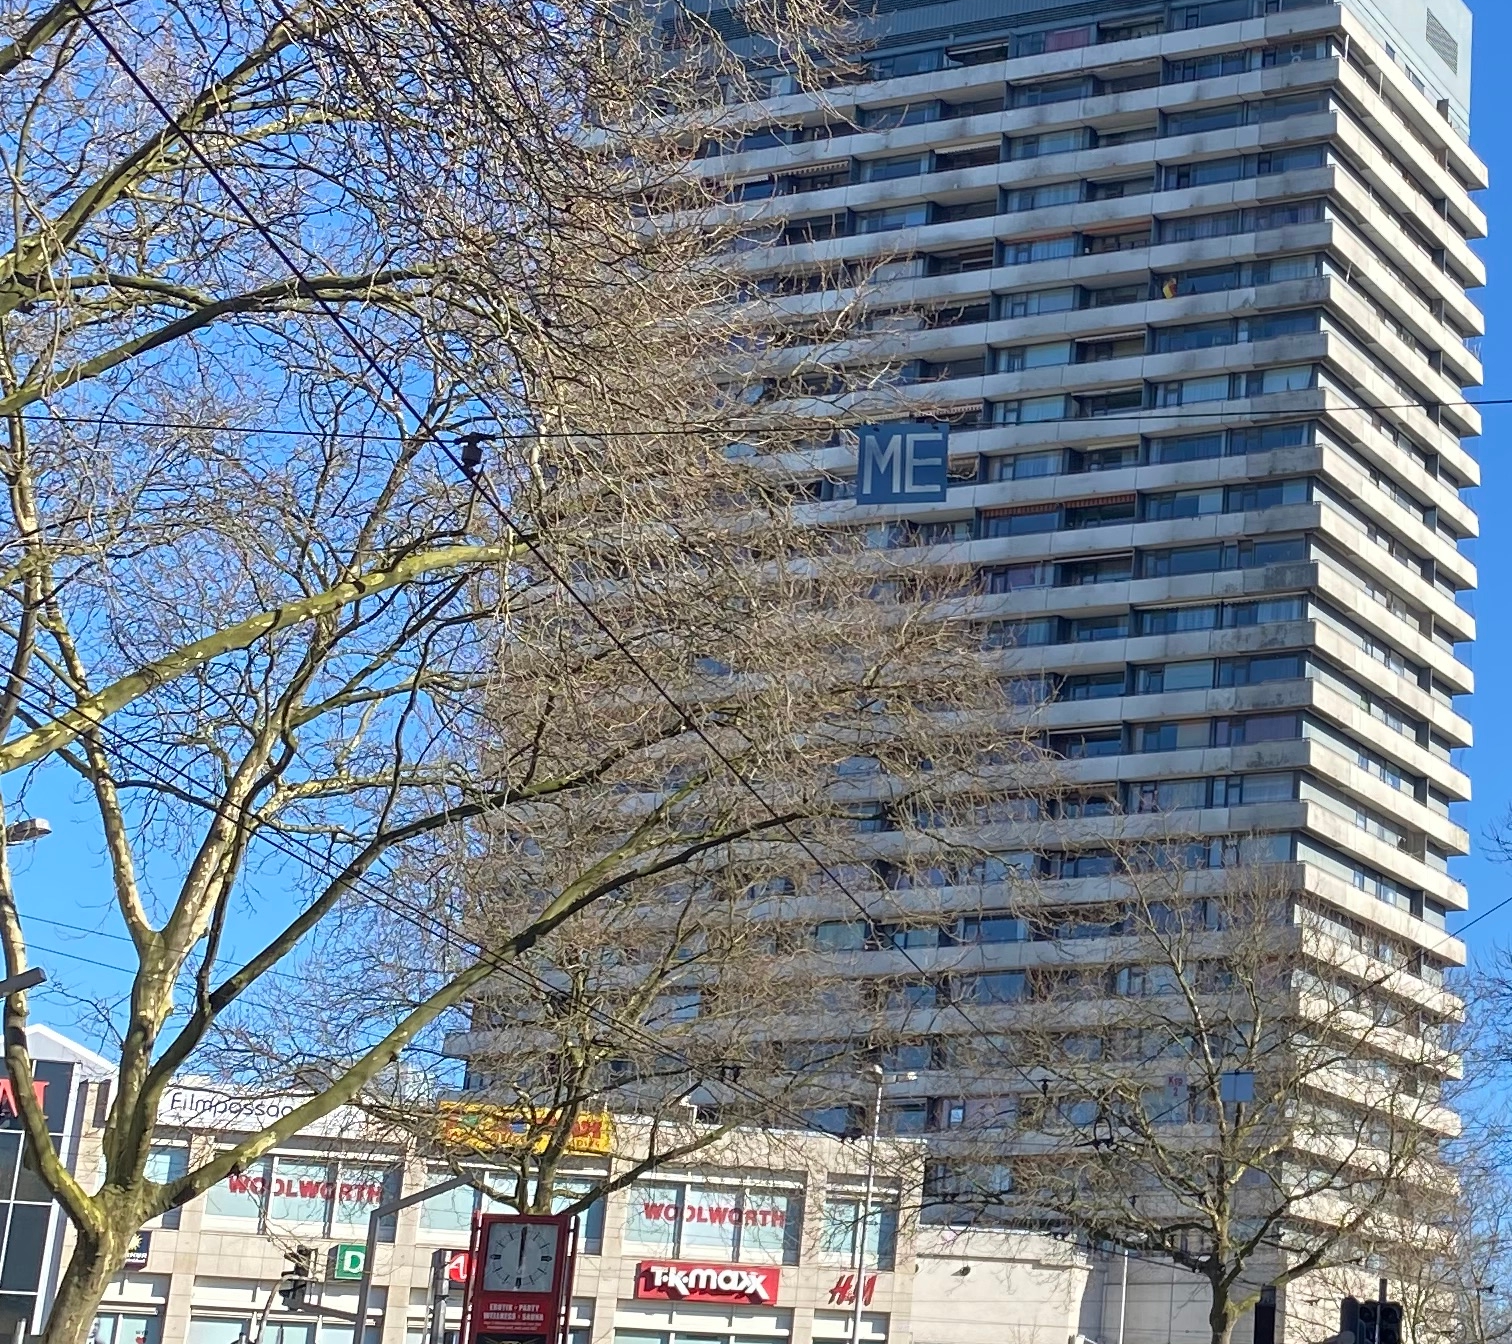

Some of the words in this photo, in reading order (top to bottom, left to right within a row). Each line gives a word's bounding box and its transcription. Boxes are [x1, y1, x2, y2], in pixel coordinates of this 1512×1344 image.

[862, 433, 943, 494] ME
[228, 1174, 383, 1203] WOOLWORTH
[642, 1202, 787, 1229] WOOLWORTH
